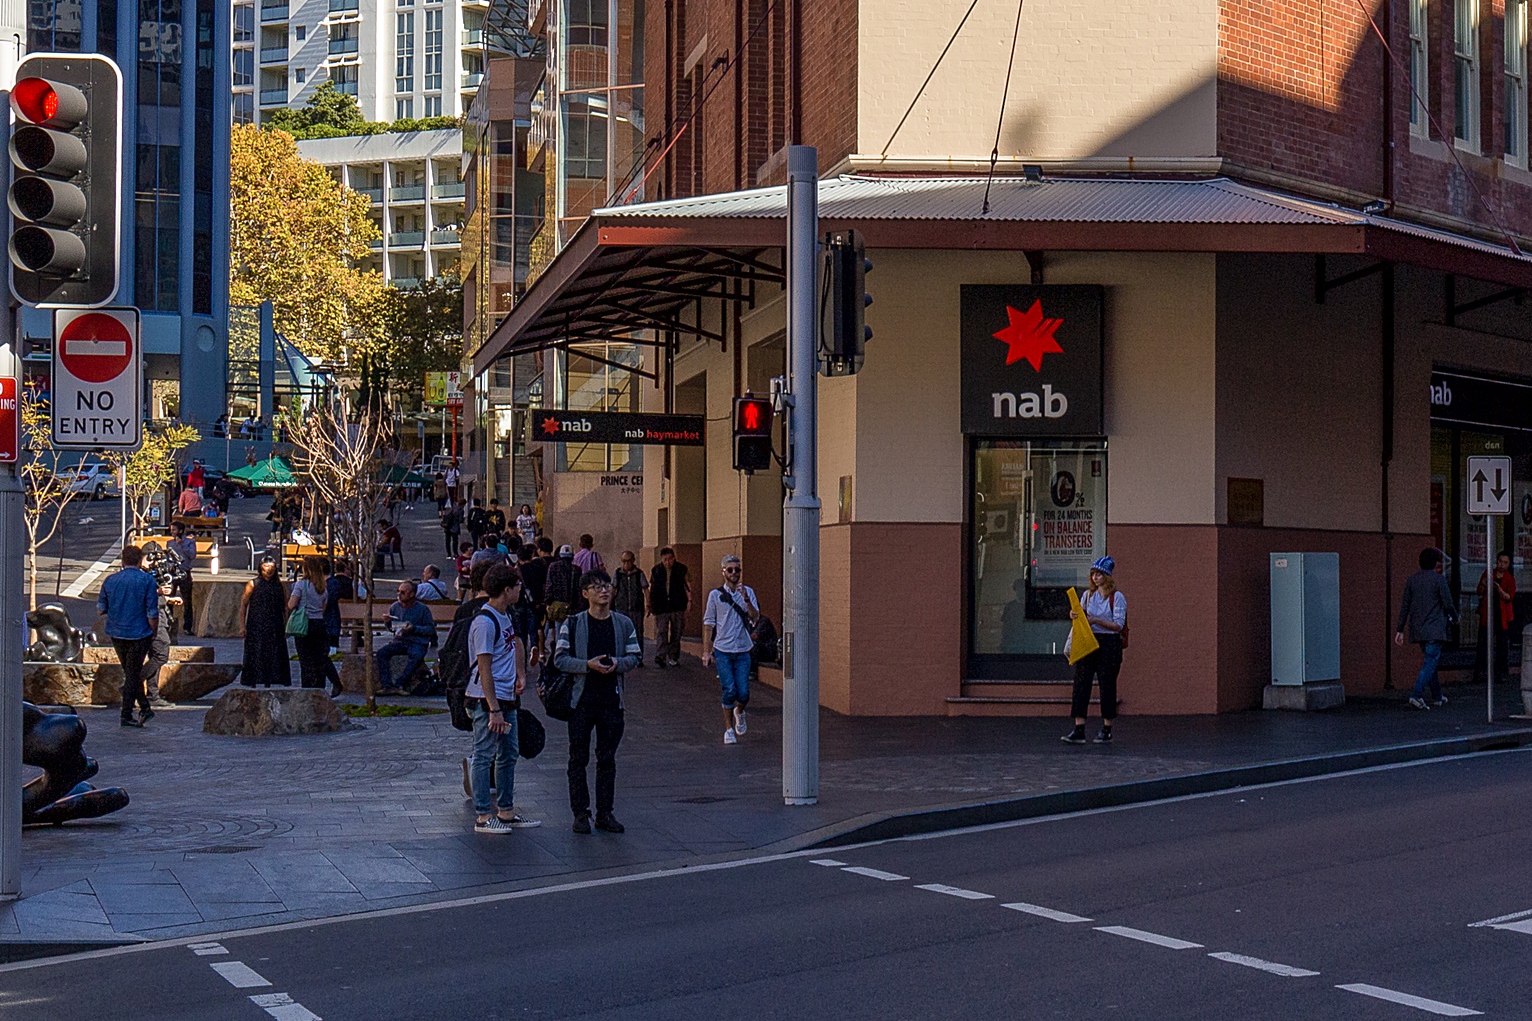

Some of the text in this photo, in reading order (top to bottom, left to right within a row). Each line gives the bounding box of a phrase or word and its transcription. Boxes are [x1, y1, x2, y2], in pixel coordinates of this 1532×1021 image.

[76, 390, 115, 411] NO
[992, 384, 1068, 418] nab
[60, 418, 131, 435] ENTRY
[562, 418, 592, 432] nab
[625, 429, 700, 441] nab haymarket
[600, 475, 628, 486] PRINCE
[1044, 510, 1092, 520] FOR 24 MONTHS
[1044, 521, 1092, 534] ON BALANCE
[1044, 535, 1092, 548] TRANSFERS
